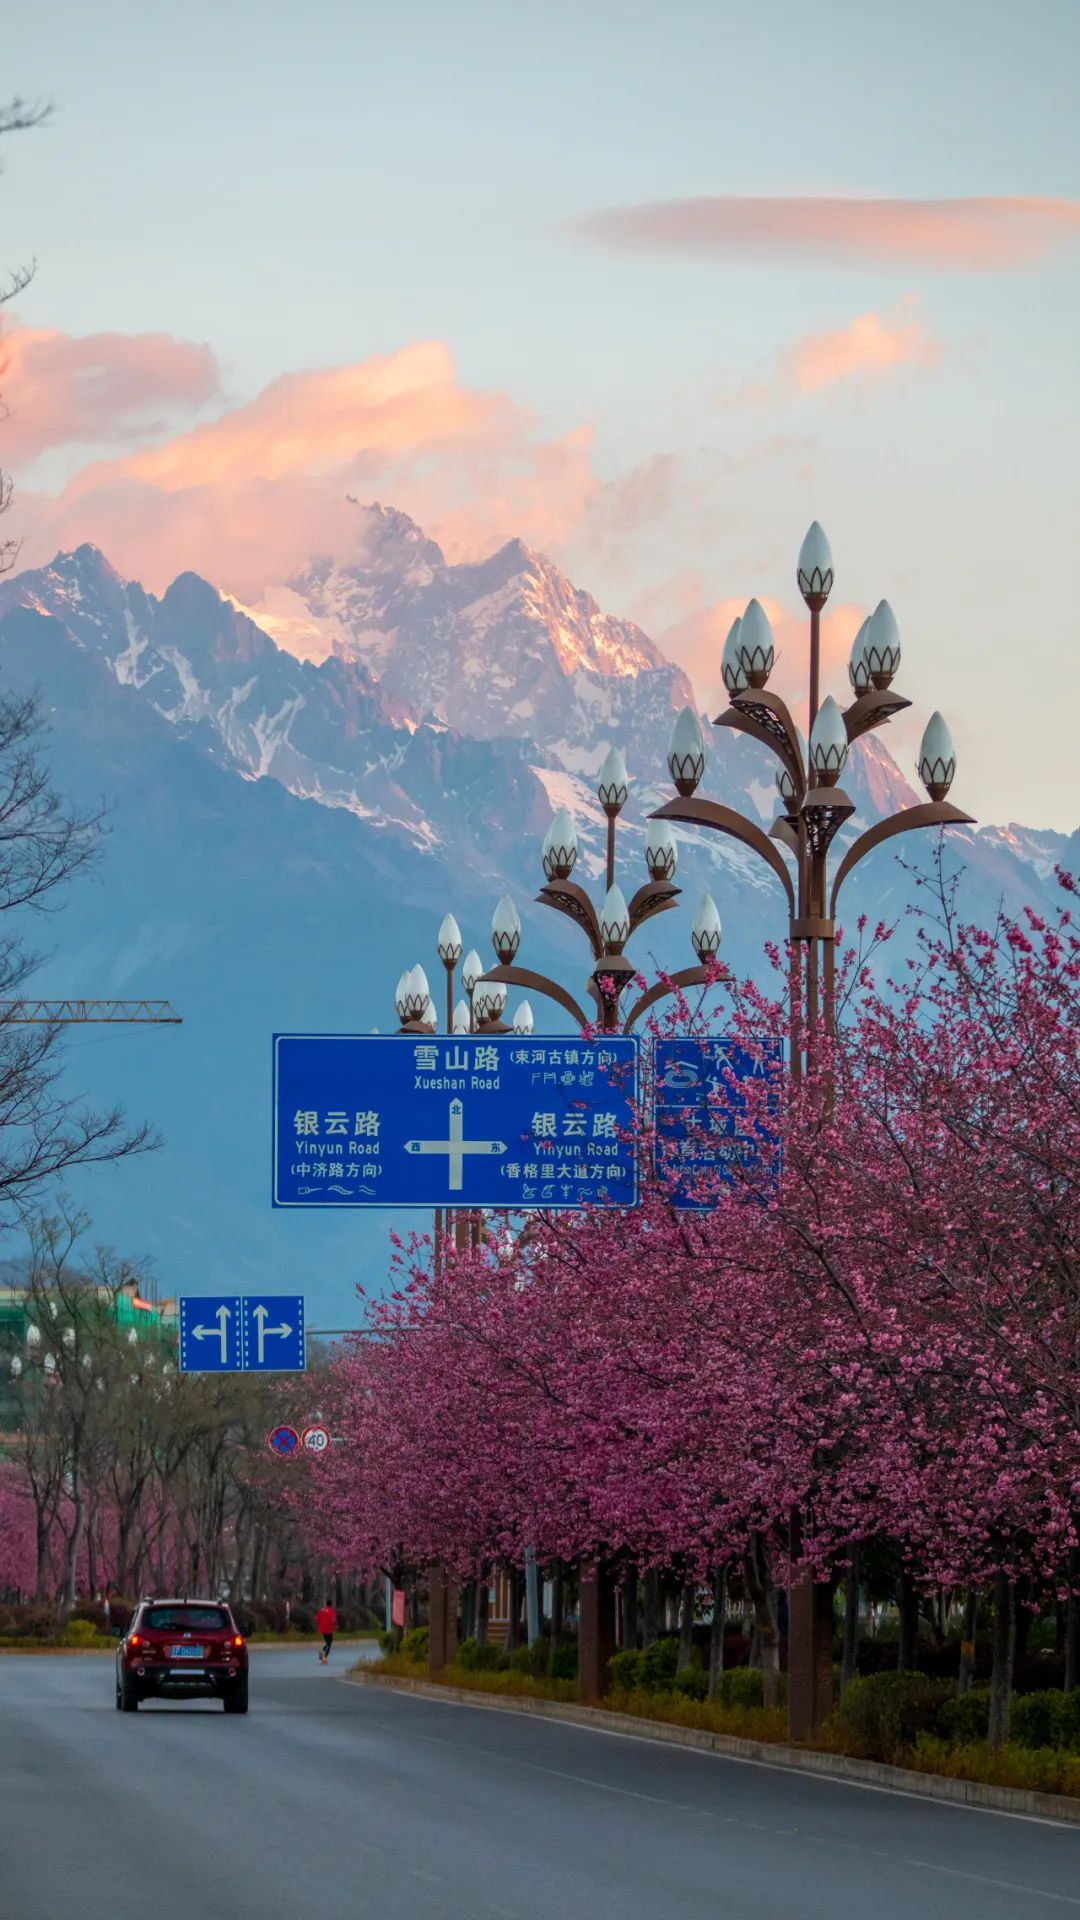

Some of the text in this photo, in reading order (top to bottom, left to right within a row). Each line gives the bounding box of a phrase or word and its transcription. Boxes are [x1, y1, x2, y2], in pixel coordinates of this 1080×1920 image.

[414, 1045, 500, 1072] 雪山路
[414, 1075, 500, 1090] Xueshan Road
[451, 1104, 461, 1115] 北
[294, 1110, 380, 1137] 银云路
[531, 1112, 617, 1138] 银云路
[295, 1141, 380, 1157] Yinyun Road
[411, 1142, 421, 1152] 西
[491, 1143, 501, 1153] 东
[587, 1142, 618, 1156] Road
[290, 1162, 382, 1178] (中济路方向)
[500, 1163, 626, 1179] (香格里大道方向)
[307, 1434, 324, 1447] 40
